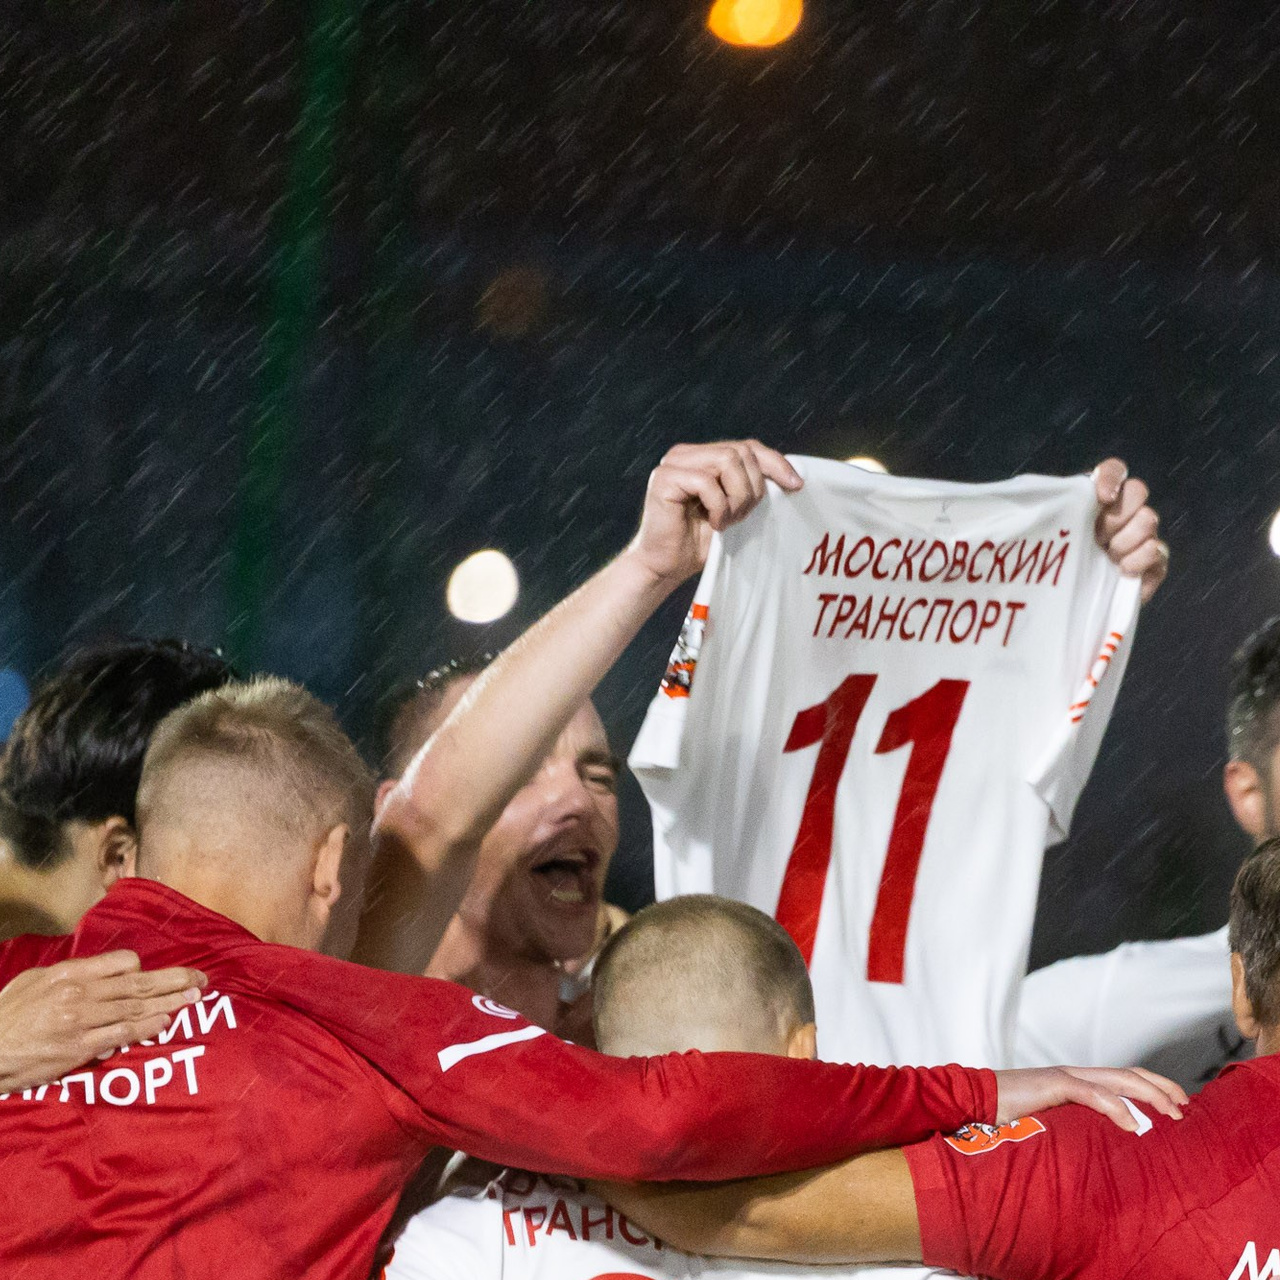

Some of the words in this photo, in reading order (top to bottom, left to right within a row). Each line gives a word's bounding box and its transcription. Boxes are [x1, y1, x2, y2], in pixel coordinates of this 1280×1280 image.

[803, 529, 1070, 586] МОСКОВСКИЙ
[812, 593, 1027, 647] ТРАНСПОРТ
[774, 673, 971, 986] 11
[502, 1199, 662, 1250] ТРАНС
